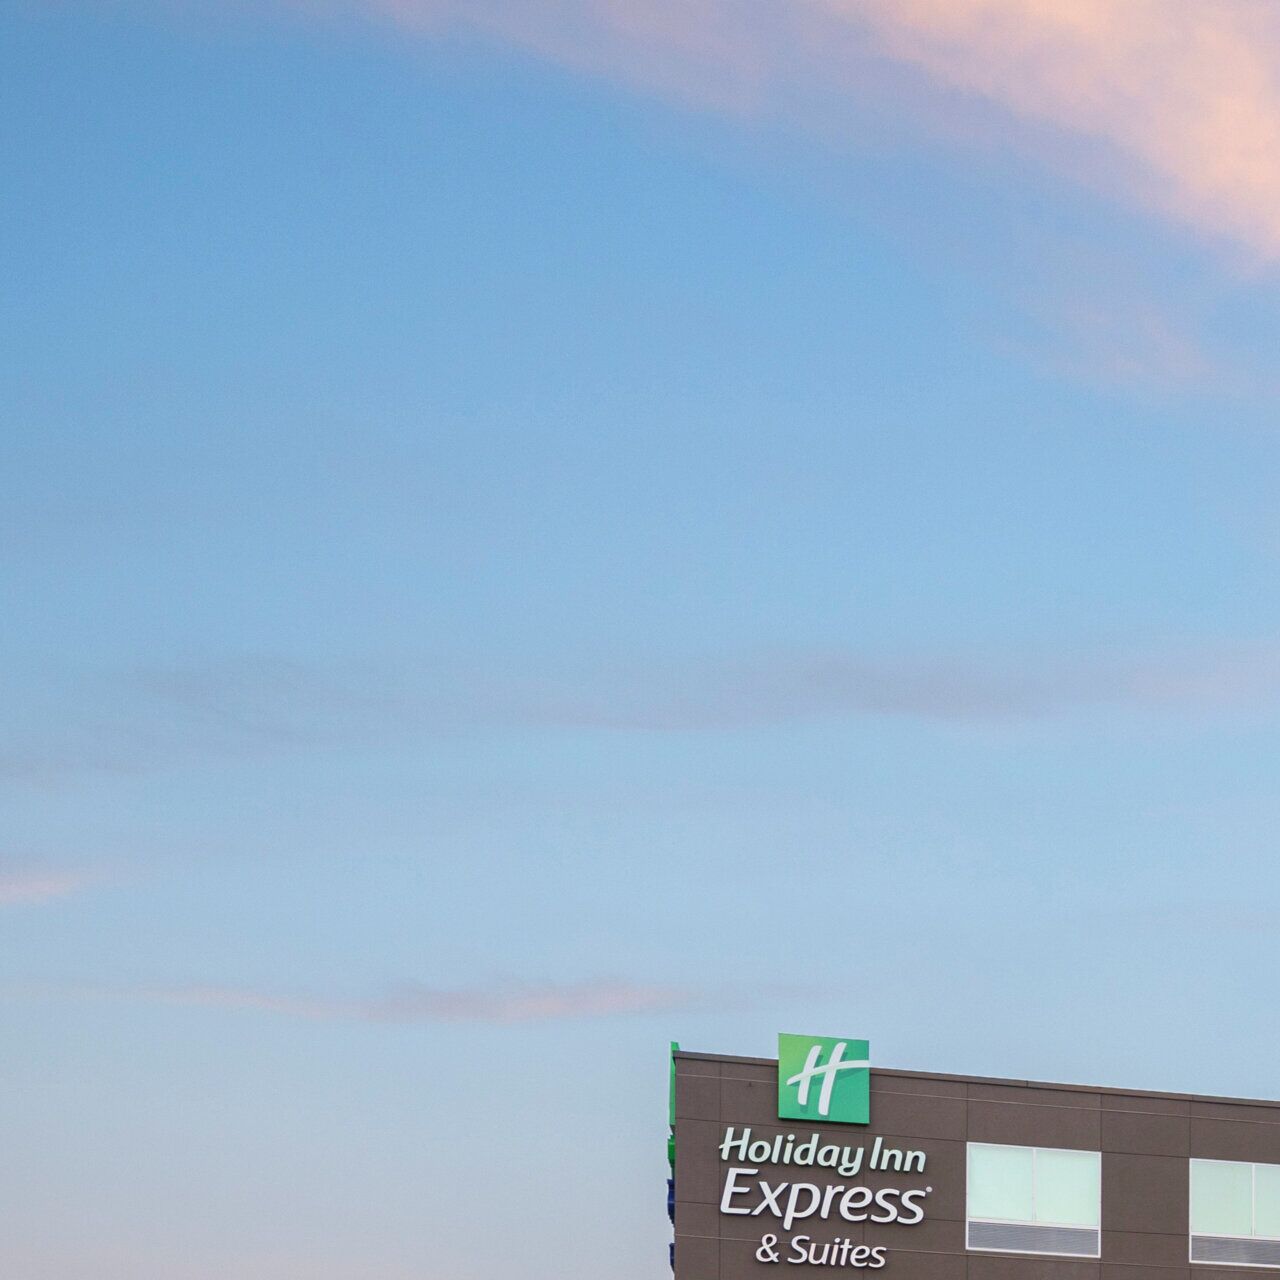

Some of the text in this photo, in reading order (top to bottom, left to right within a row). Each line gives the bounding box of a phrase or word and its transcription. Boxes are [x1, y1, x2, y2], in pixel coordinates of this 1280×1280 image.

[718, 1126, 927, 1178] Holiday Inn
[719, 1167, 927, 1231] Express
[755, 1233, 888, 1269] & Suites
